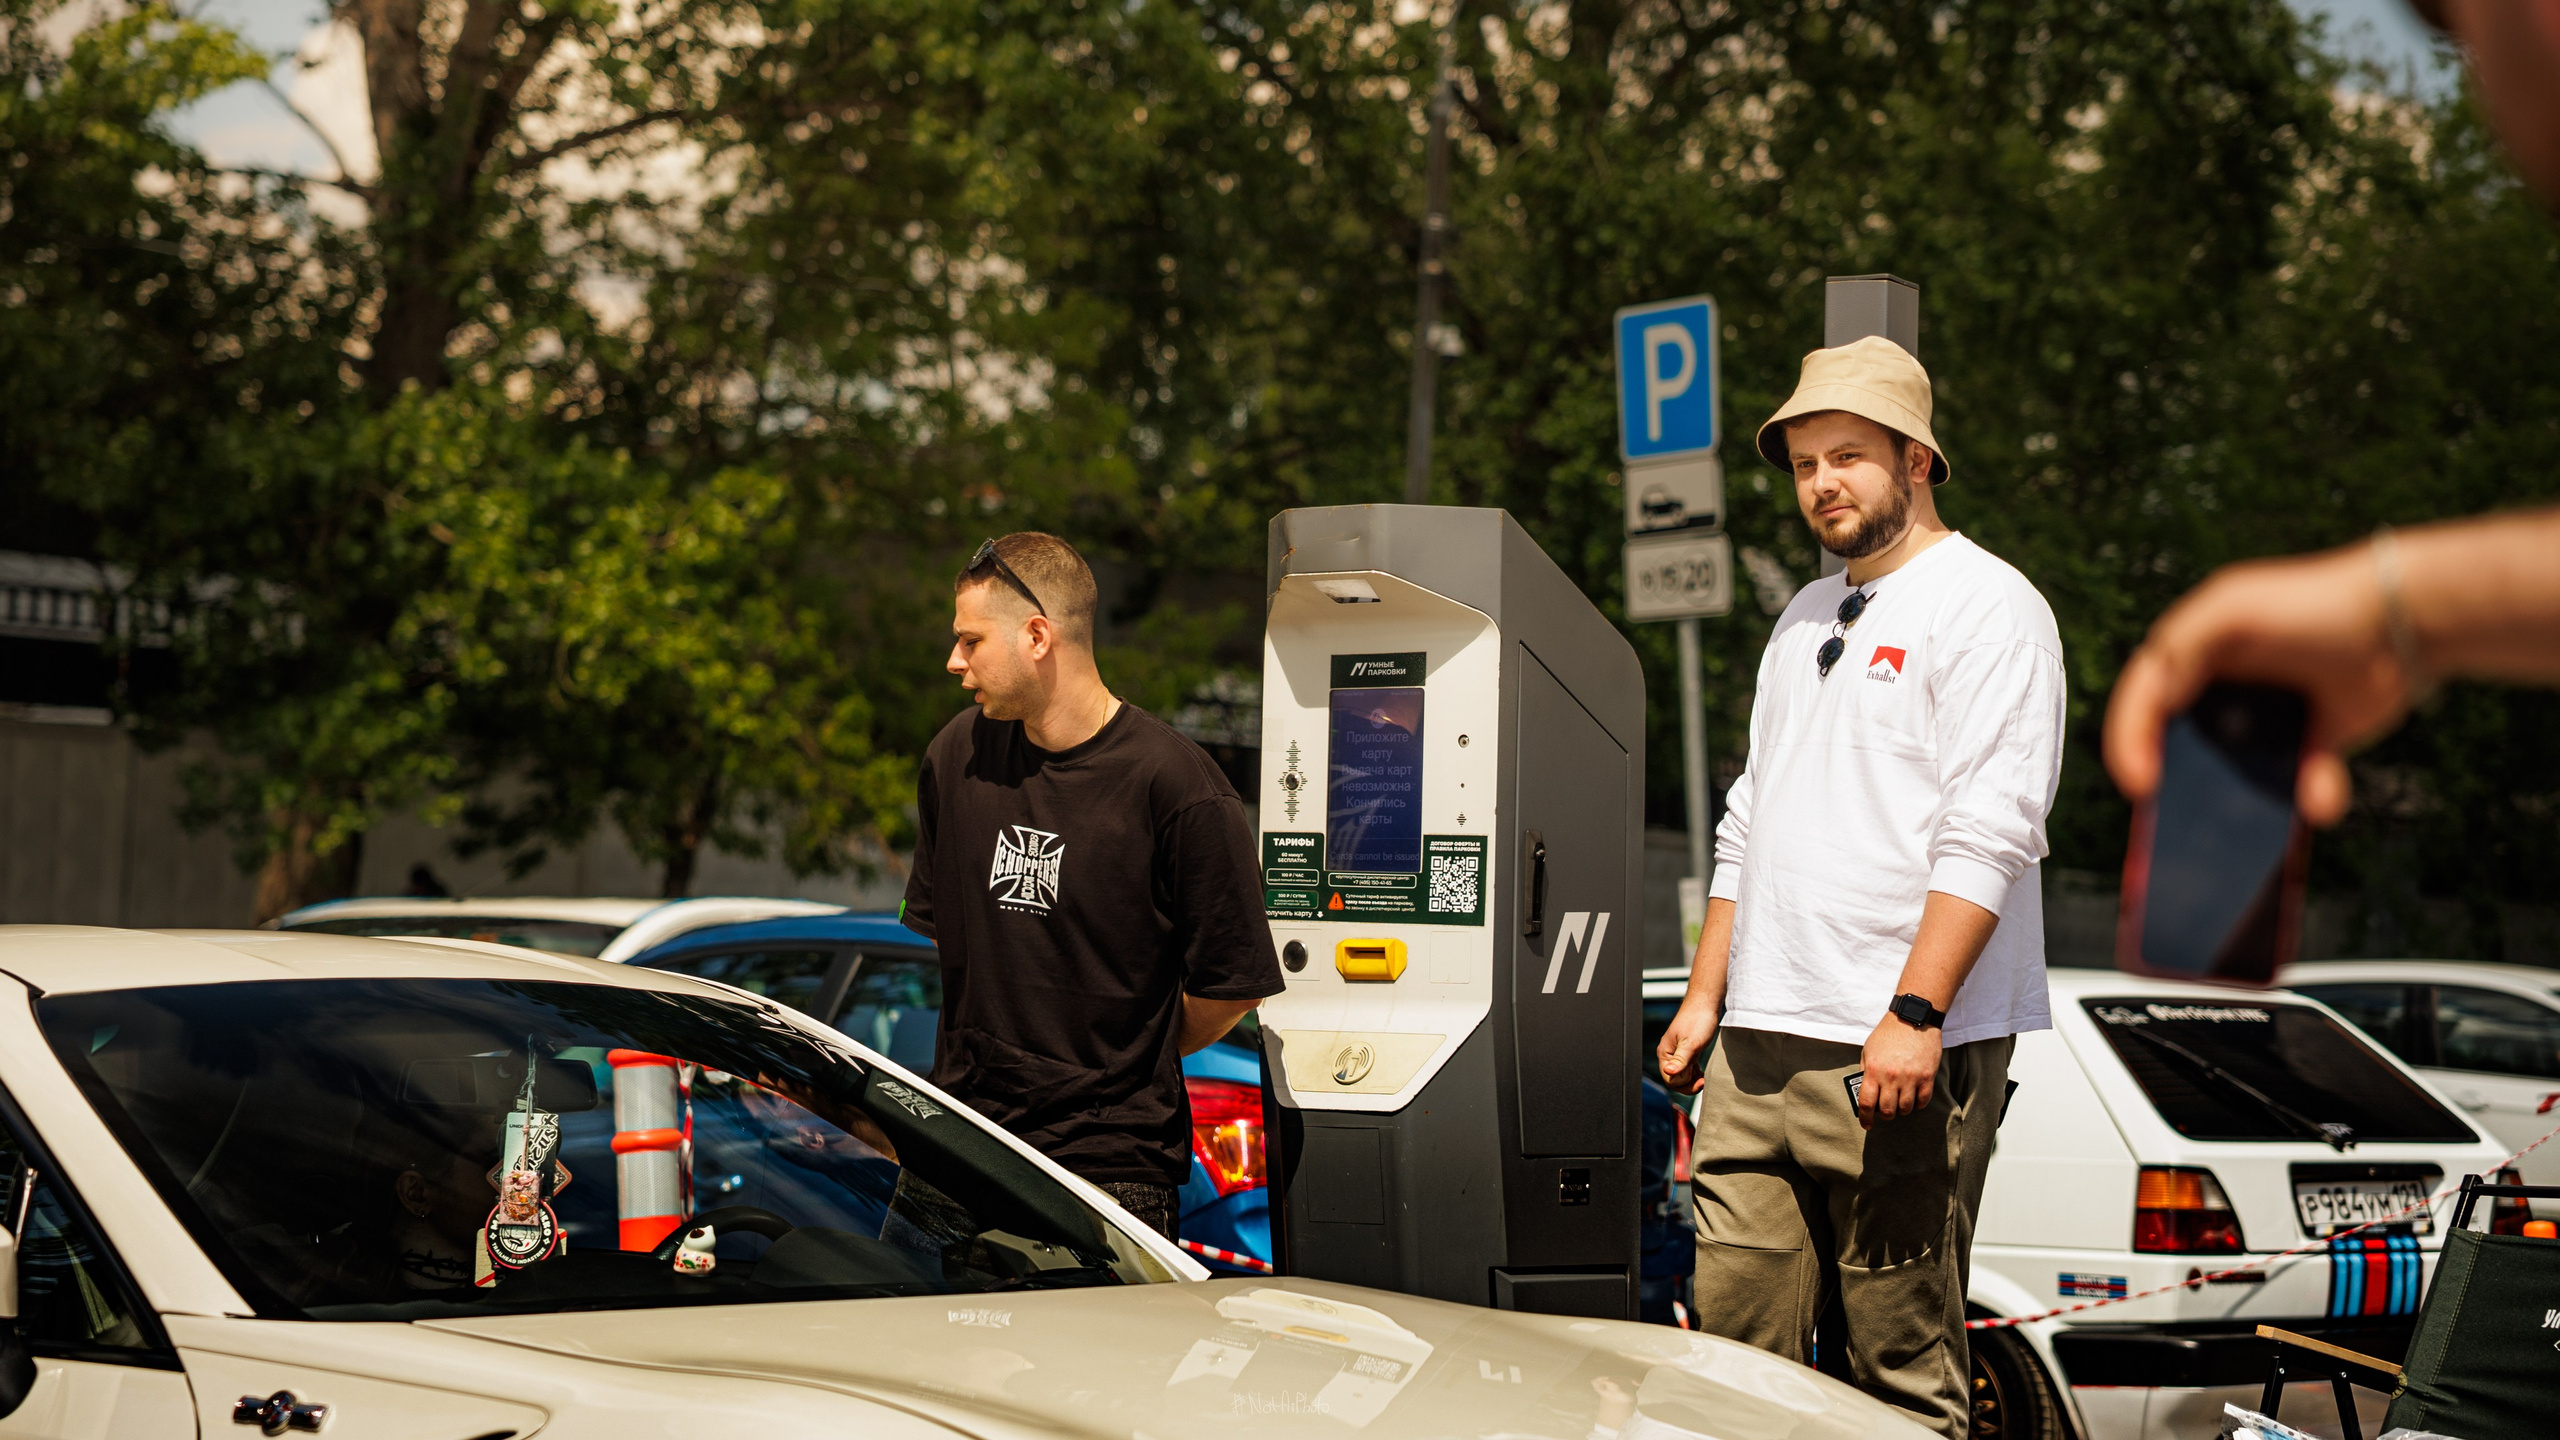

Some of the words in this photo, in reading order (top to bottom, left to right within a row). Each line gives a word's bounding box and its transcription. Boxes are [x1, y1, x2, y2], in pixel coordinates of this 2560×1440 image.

[1643, 321, 1697, 441] P
[1683, 558, 1711, 591] 20
[1368, 661, 1395, 669] УМНЫЕ
[1367, 668, 1406, 676] ПАРКОВКИ
[1346, 731, 1409, 745] Приложите
[1361, 749, 1393, 761] карту
[1341, 764, 1385, 776] Выдача
[1387, 766, 1413, 777] карт
[1342, 782, 1411, 792] невозможна
[1346, 796, 1407, 808] Кончились
[1359, 815, 1393, 827] карты
[1273, 837, 1315, 847] ТАРИФЫ
[1382, 852, 1393, 861] be
[1394, 851, 1420, 861] issued
